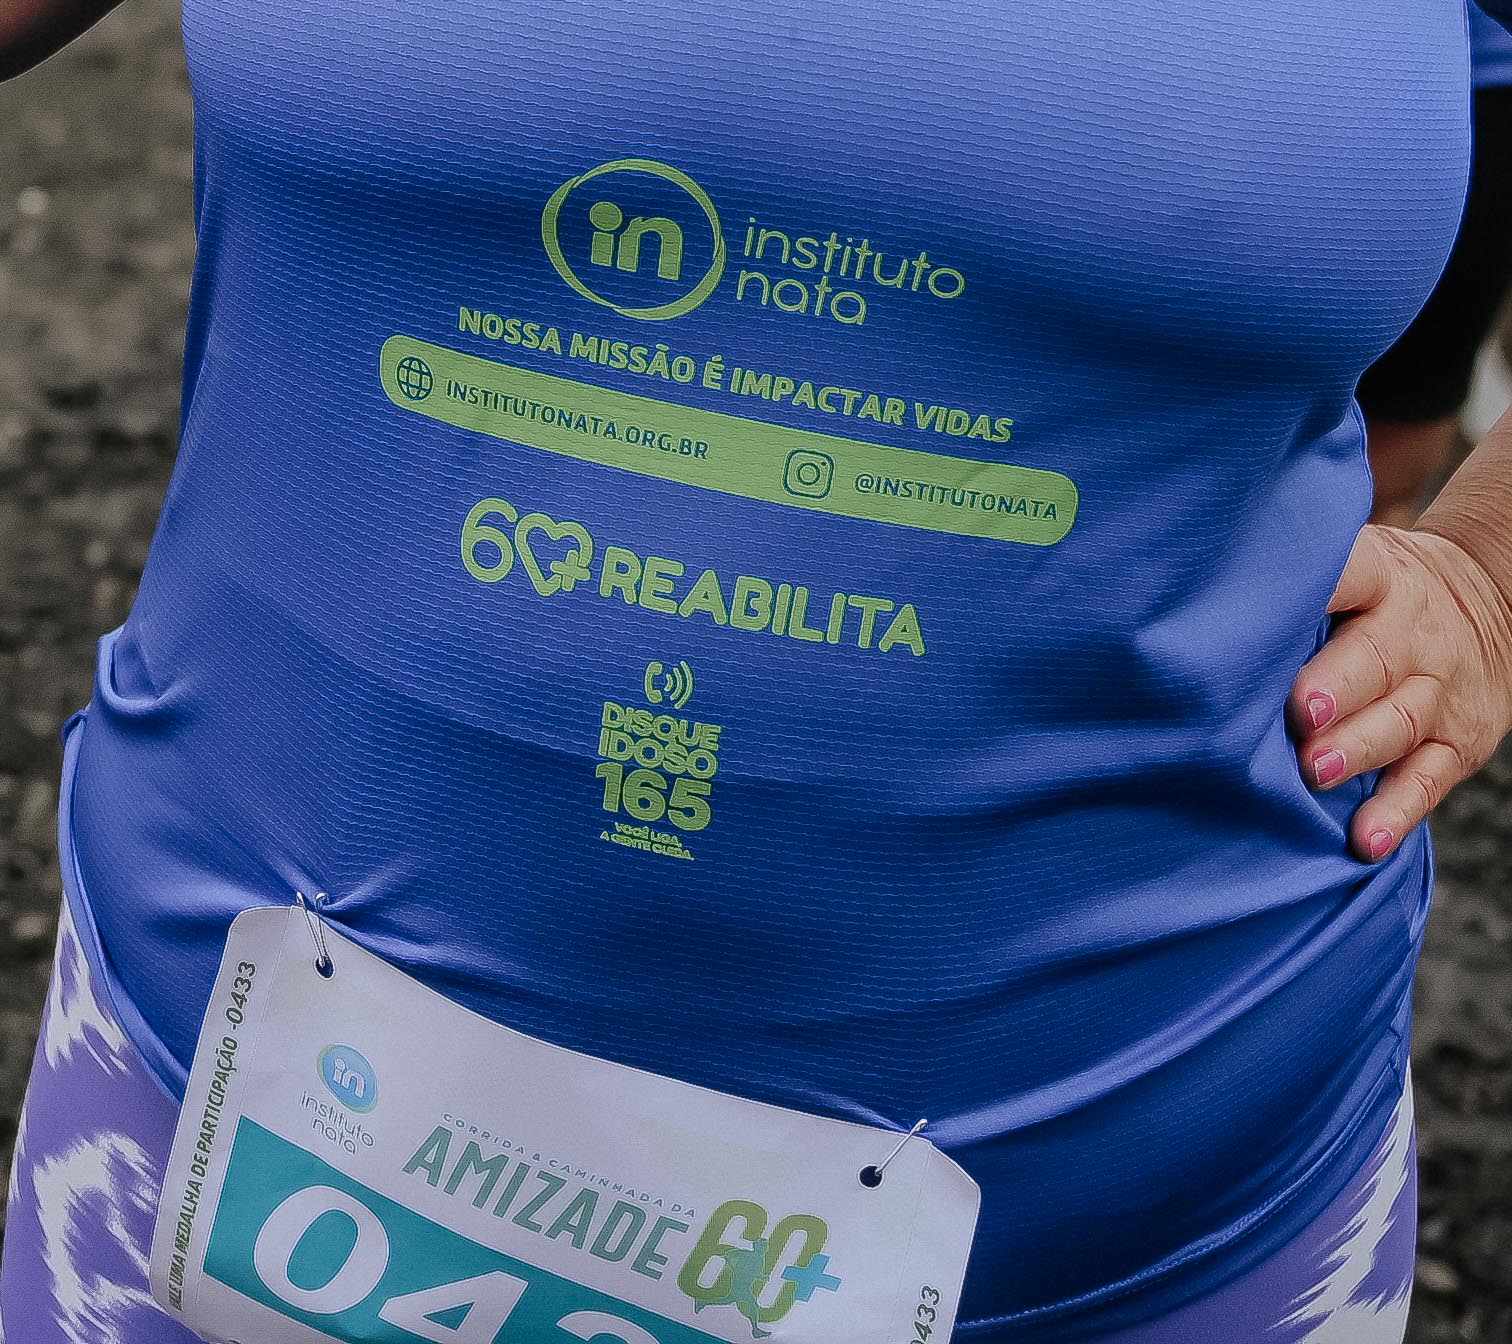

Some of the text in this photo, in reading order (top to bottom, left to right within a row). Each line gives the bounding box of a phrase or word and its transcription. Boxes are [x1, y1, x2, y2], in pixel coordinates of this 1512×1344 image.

[743, 216, 967, 300] instituto
[736, 269, 868, 326] nata
[458, 306, 1014, 444] NOSSA MISSÃO É IMPACTAR VIDAS
[444, 378, 1059, 523] INSTITUTONATA.ORG.BR @INSTITUTONATA
[598, 545, 927, 658] REABILITA
[597, 727, 719, 780] IDOSO
[601, 700, 723, 752] DISQUE
[594, 761, 713, 832] 165
[195, 1035, 239, 1155] PARTICIPAÇÃO
[300, 1090, 375, 1147] instituto
[189, 1152, 210, 1179] DE
[312, 1117, 357, 1155] nata
[441, 1112, 697, 1219] CORRIDA & CAMINHADA DA
[174, 1178, 204, 1256] MEDALHA
[402, 1124, 843, 1325] AMIZADE 60+
[169, 1252, 187, 1287] UMA
[909, 1285, 941, 1344] 433
